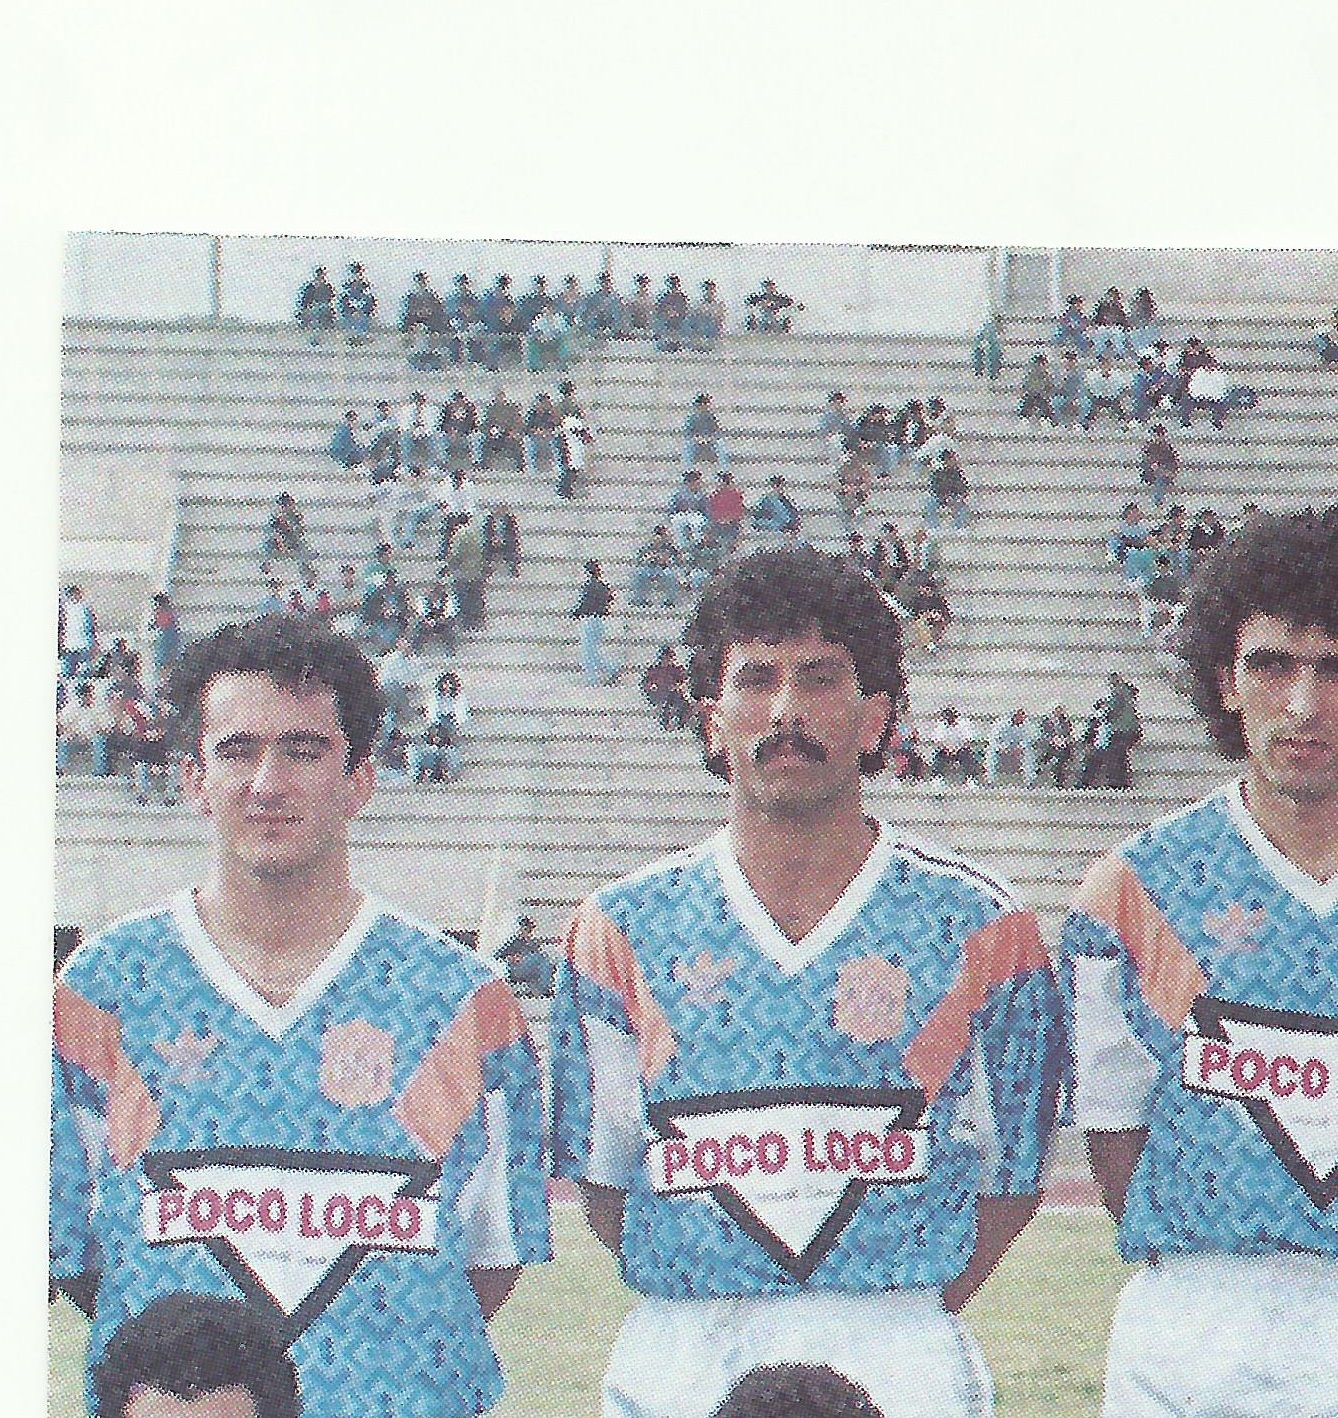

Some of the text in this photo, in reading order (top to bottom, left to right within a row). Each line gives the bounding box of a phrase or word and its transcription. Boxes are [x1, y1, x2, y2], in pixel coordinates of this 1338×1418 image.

[1200, 1043, 1330, 1099] POCO
[662, 1128, 915, 1184] POCO LOCO
[157, 1188, 422, 1239] POCO LOCO
